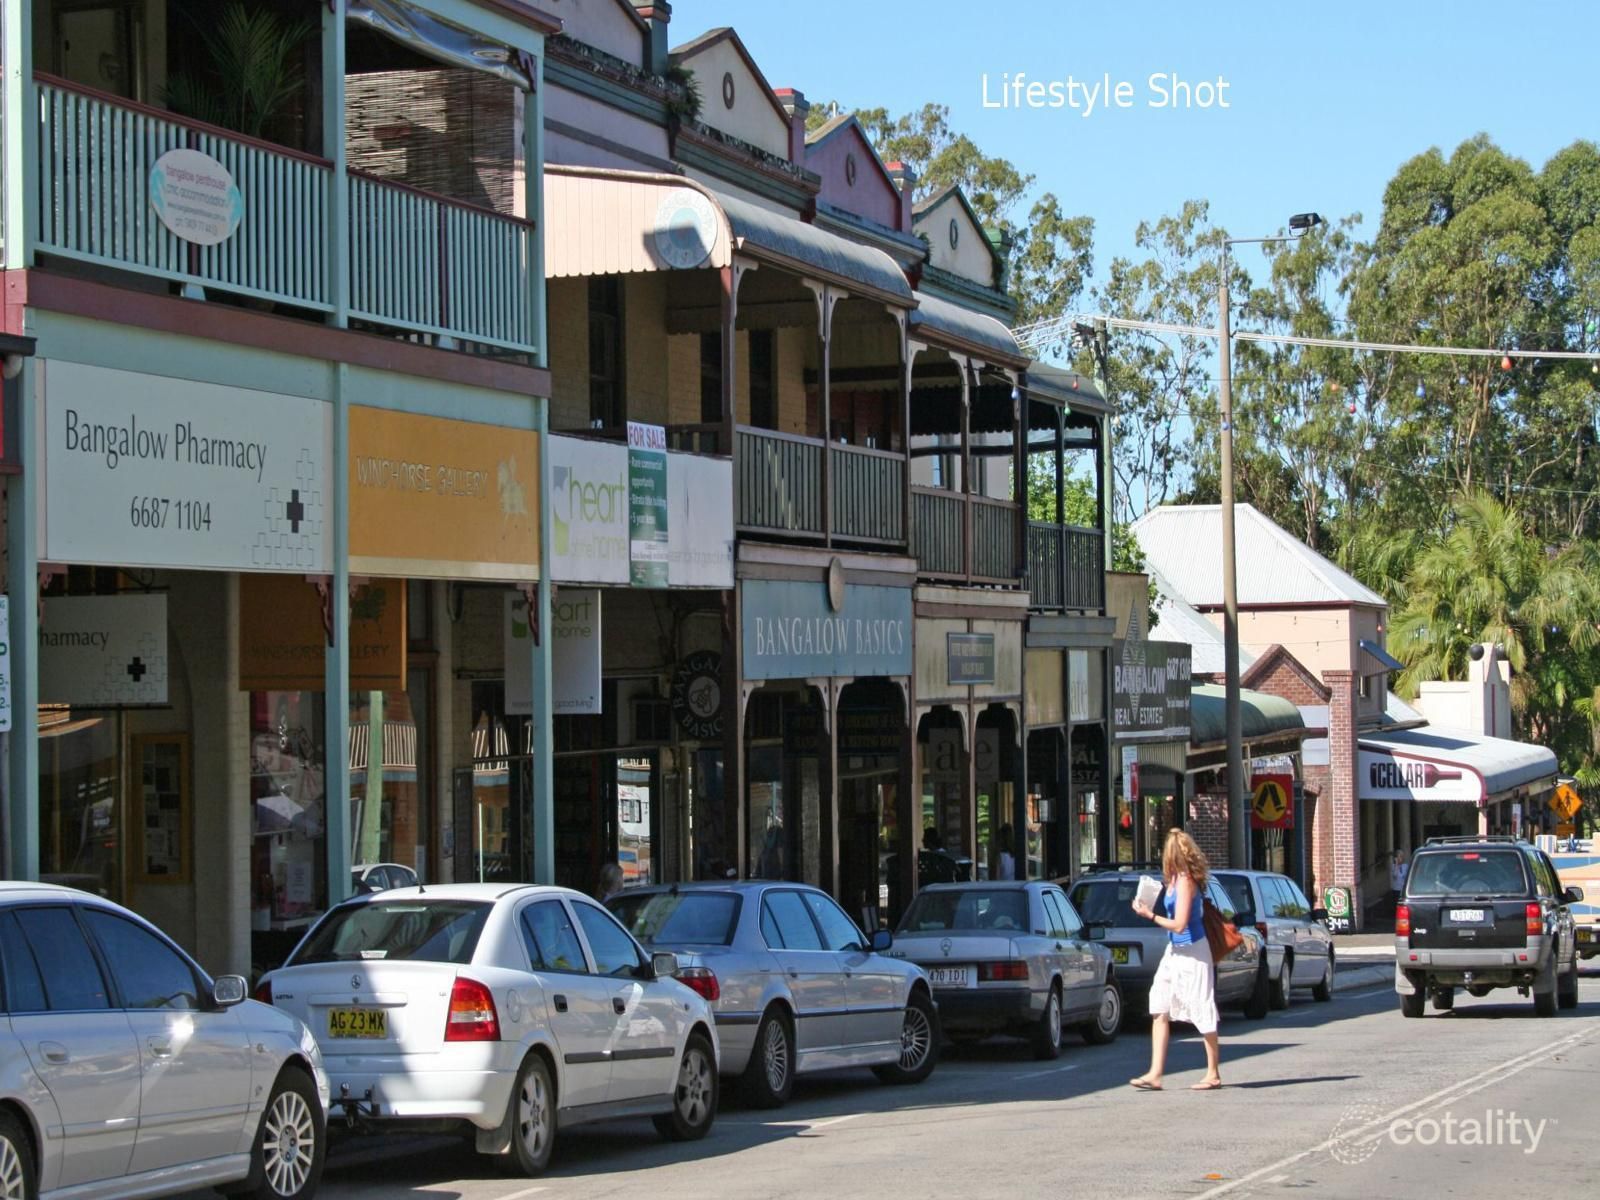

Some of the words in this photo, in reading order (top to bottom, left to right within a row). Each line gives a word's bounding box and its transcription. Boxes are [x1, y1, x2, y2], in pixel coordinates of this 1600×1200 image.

[66, 409, 168, 469] Bangalow
[175, 421, 267, 483] Pharmacy
[629, 426, 644, 446] FOR
[646, 428, 666, 449] SALE
[437, 464, 489, 498] GALLERY
[568, 466, 626, 523] heart
[131, 496, 170, 528] 6687
[174, 500, 211, 531] 1104
[40, 631, 109, 652] harmacy
[755, 616, 849, 656] BANGALOW
[855, 619, 904, 655] BASICS
[1114, 665, 1166, 694] BANGALOW
[682, 714, 723, 737] BASIC
[1114, 708, 1131, 725] REAL
[1140, 707, 1159, 725] ESTATE
[1378, 763, 1423, 788] CELLAR
